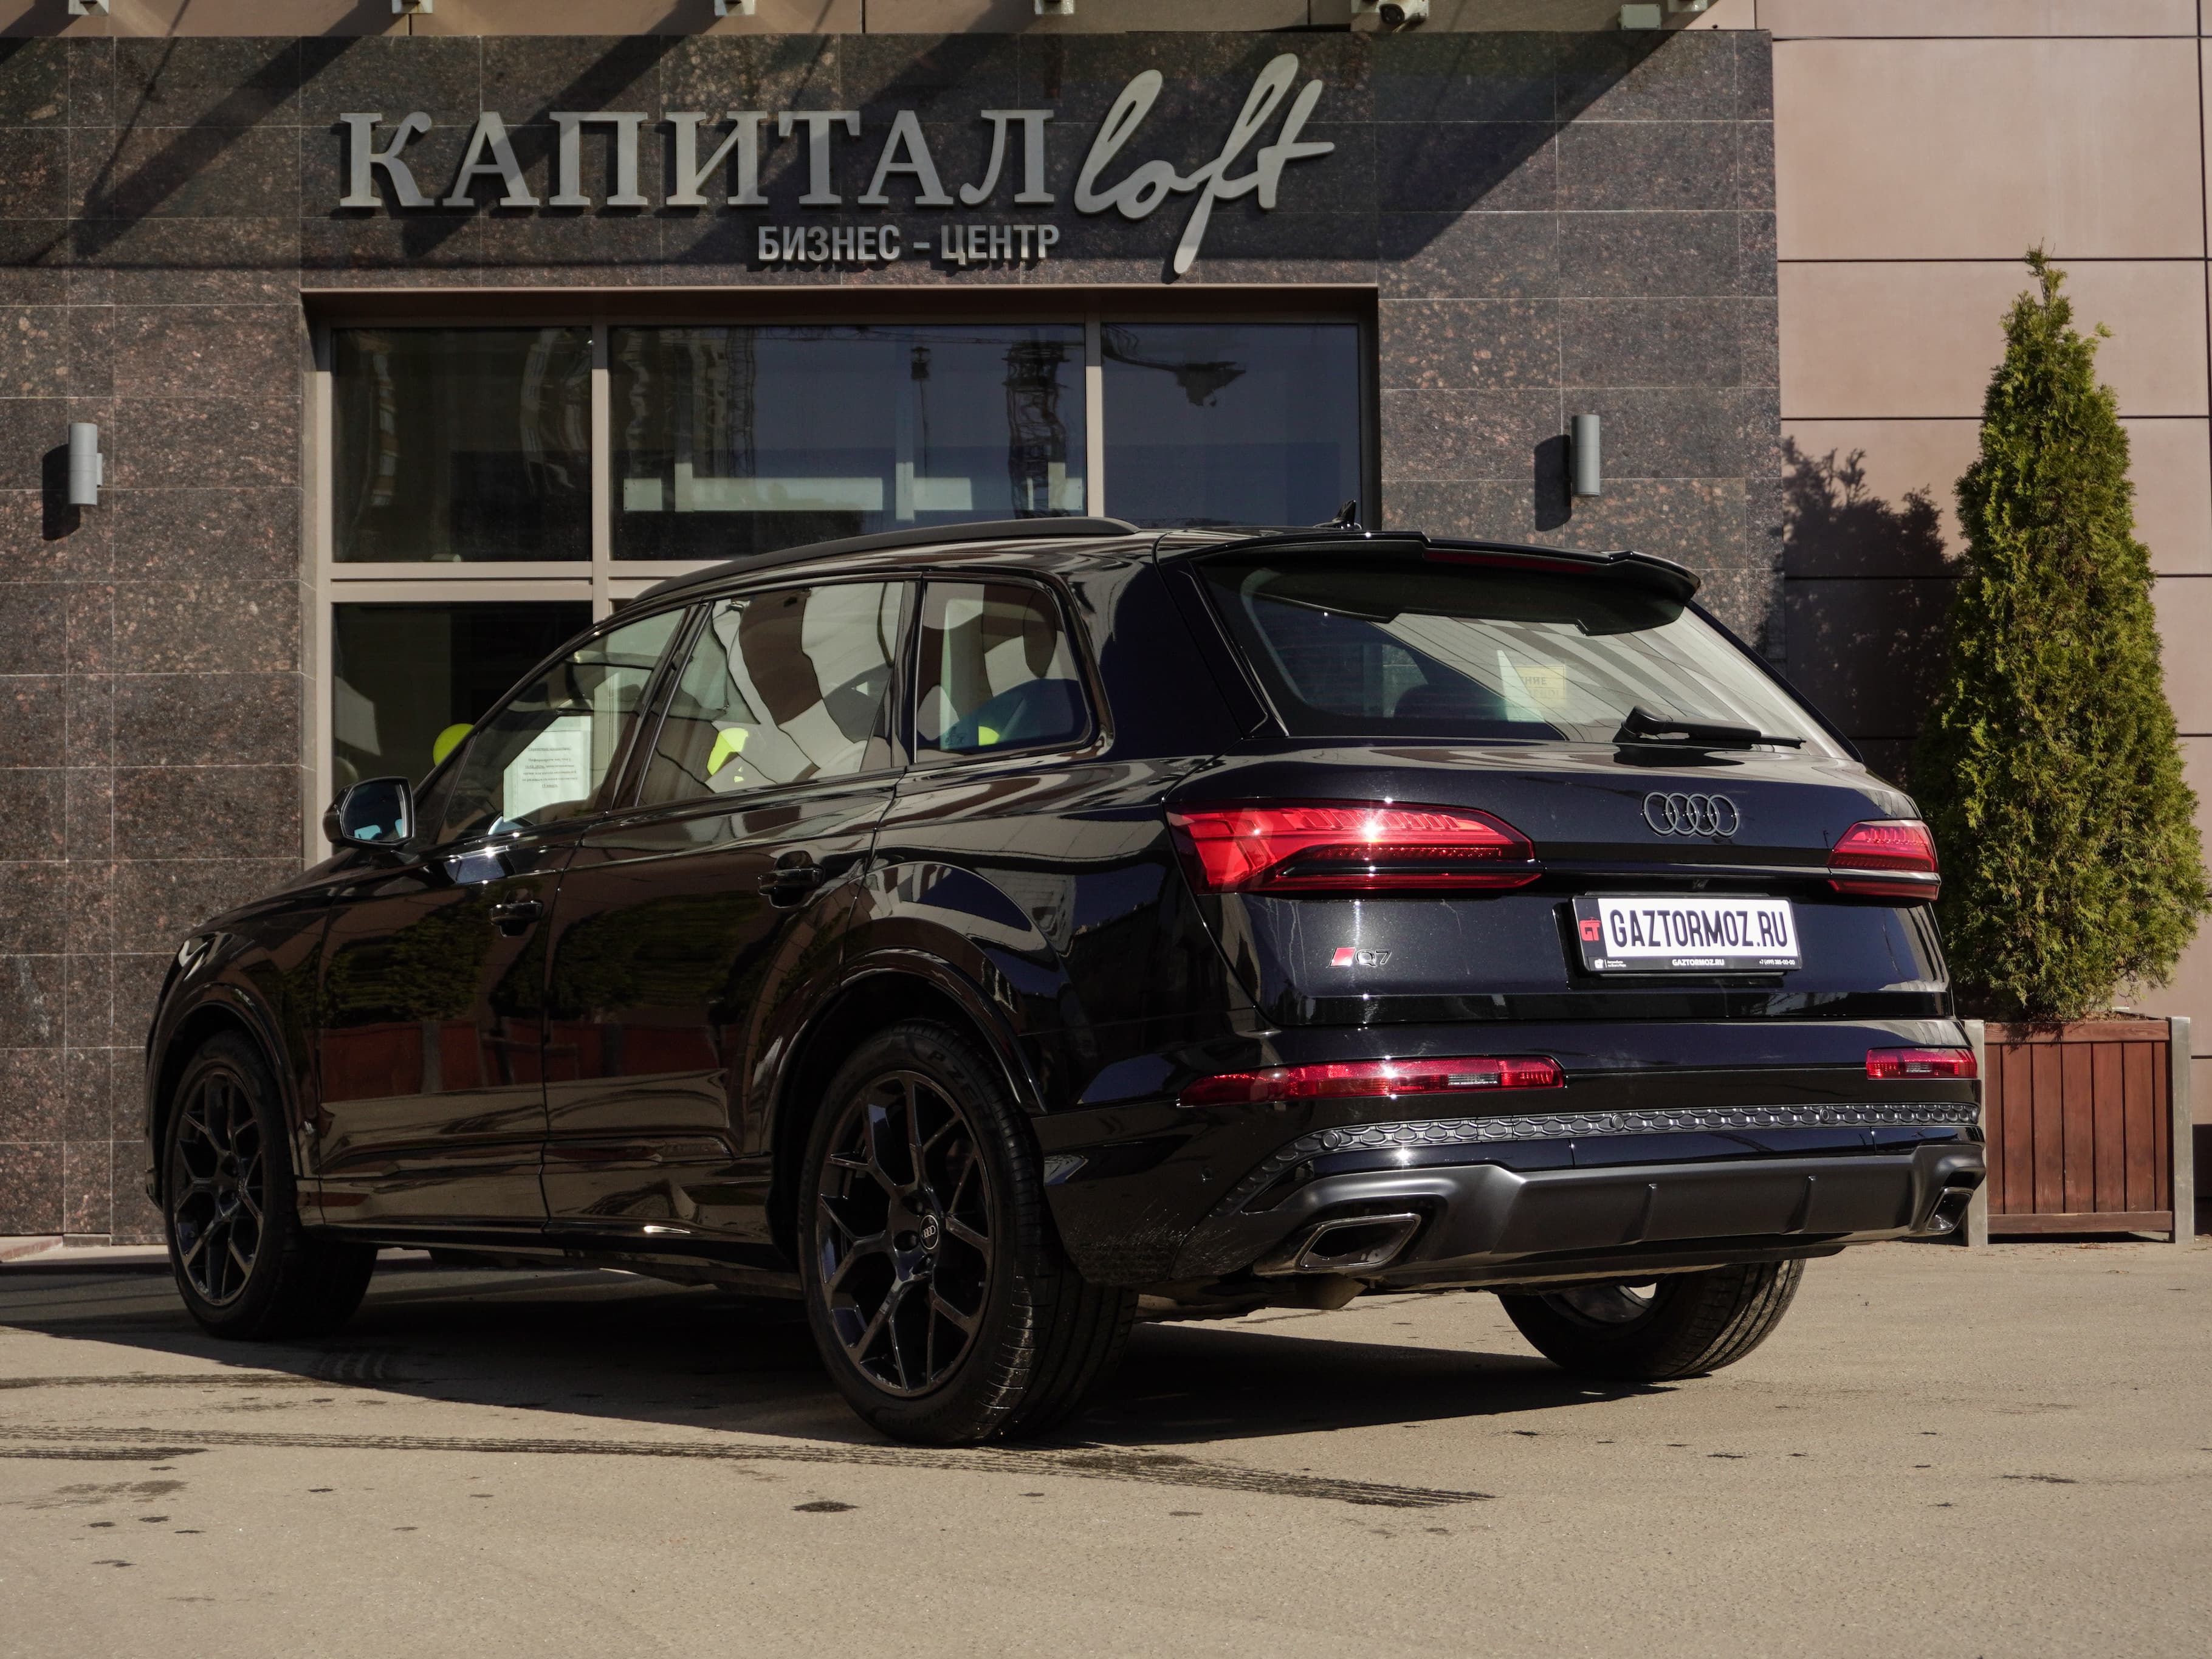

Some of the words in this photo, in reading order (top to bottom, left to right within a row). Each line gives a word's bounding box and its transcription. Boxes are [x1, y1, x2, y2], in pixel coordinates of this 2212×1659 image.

[340, 109, 1055, 207] КАПИТАЛ
[1074, 52, 1335, 274] loft
[758, 224, 901, 262] БИЗНЕС
[941, 224, 1059, 266] ЦЕНТР
[1609, 909, 1788, 948] GAZTORMOZ.RU
[1356, 949, 1392, 967] Q7
[1672, 958, 1725, 967] GAZTORMOZ.RU
